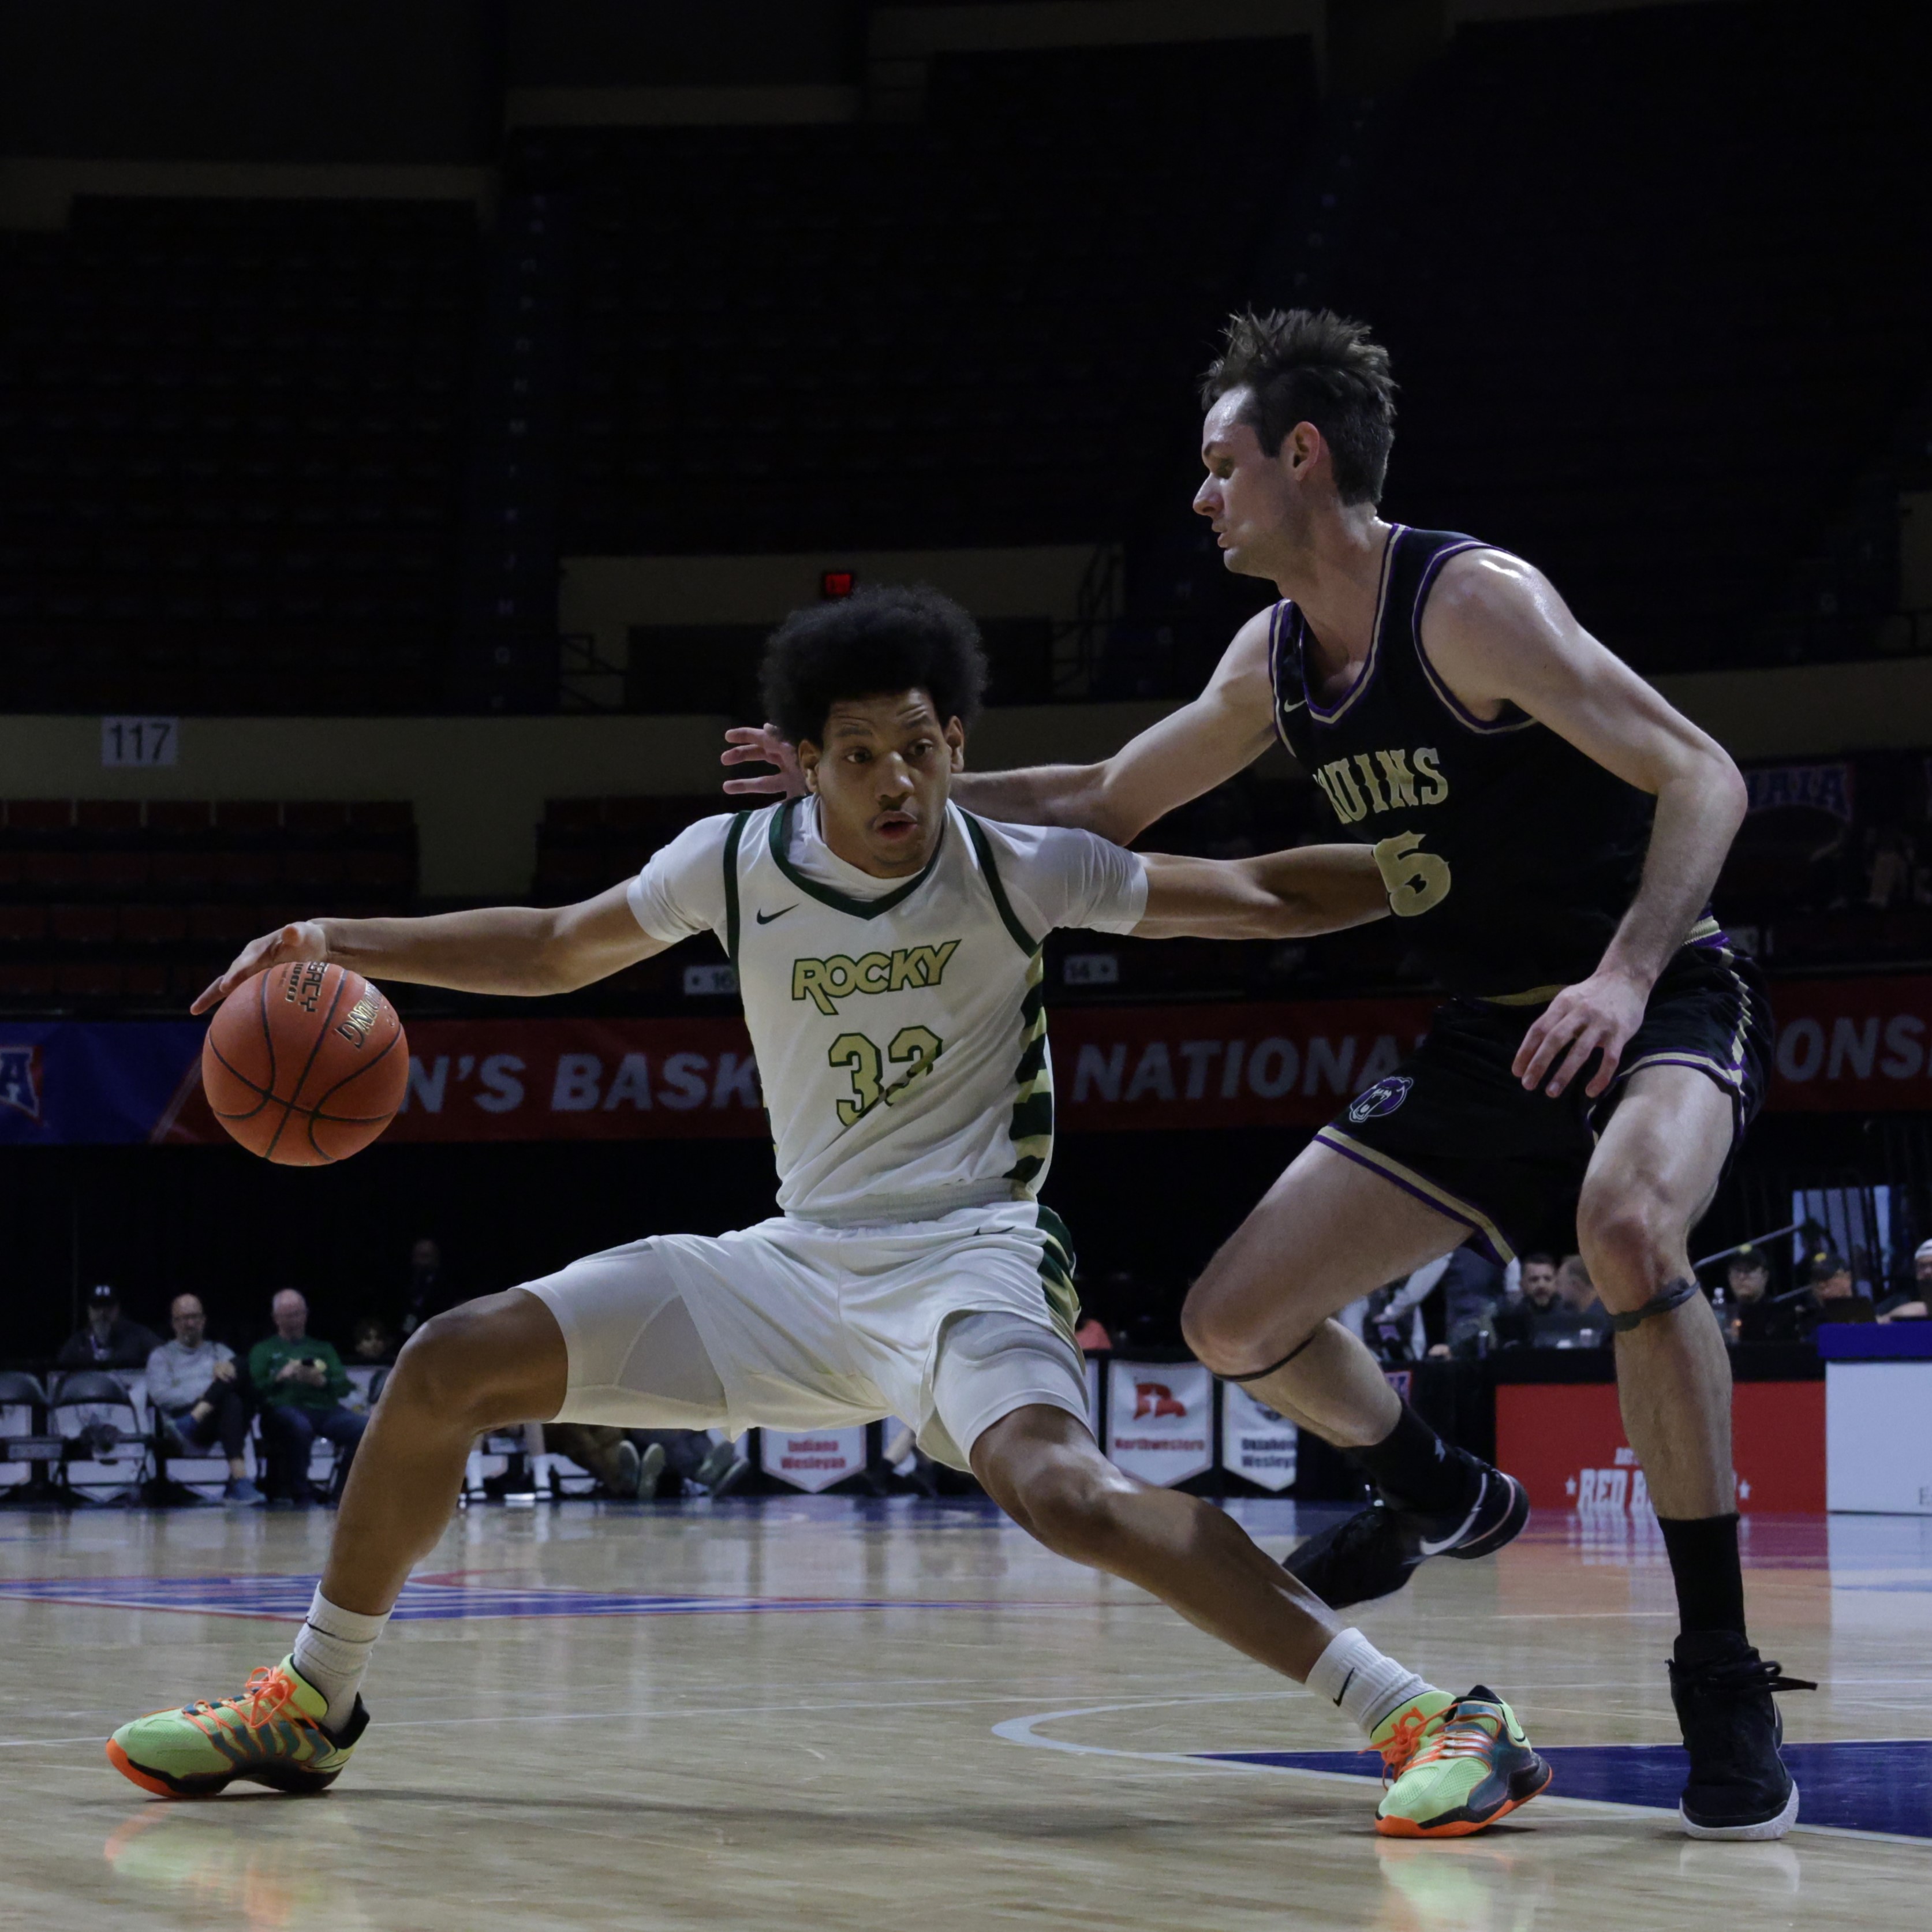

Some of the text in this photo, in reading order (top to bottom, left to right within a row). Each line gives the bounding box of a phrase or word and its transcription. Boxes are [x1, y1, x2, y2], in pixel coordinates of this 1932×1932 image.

[109, 723, 171, 761] 117
[791, 939, 962, 1016] ROCKY
[828, 1025, 944, 1127] 32
[1071, 1033, 1427, 1103] NATIONA
[1776, 1012, 1932, 1083] ONS
